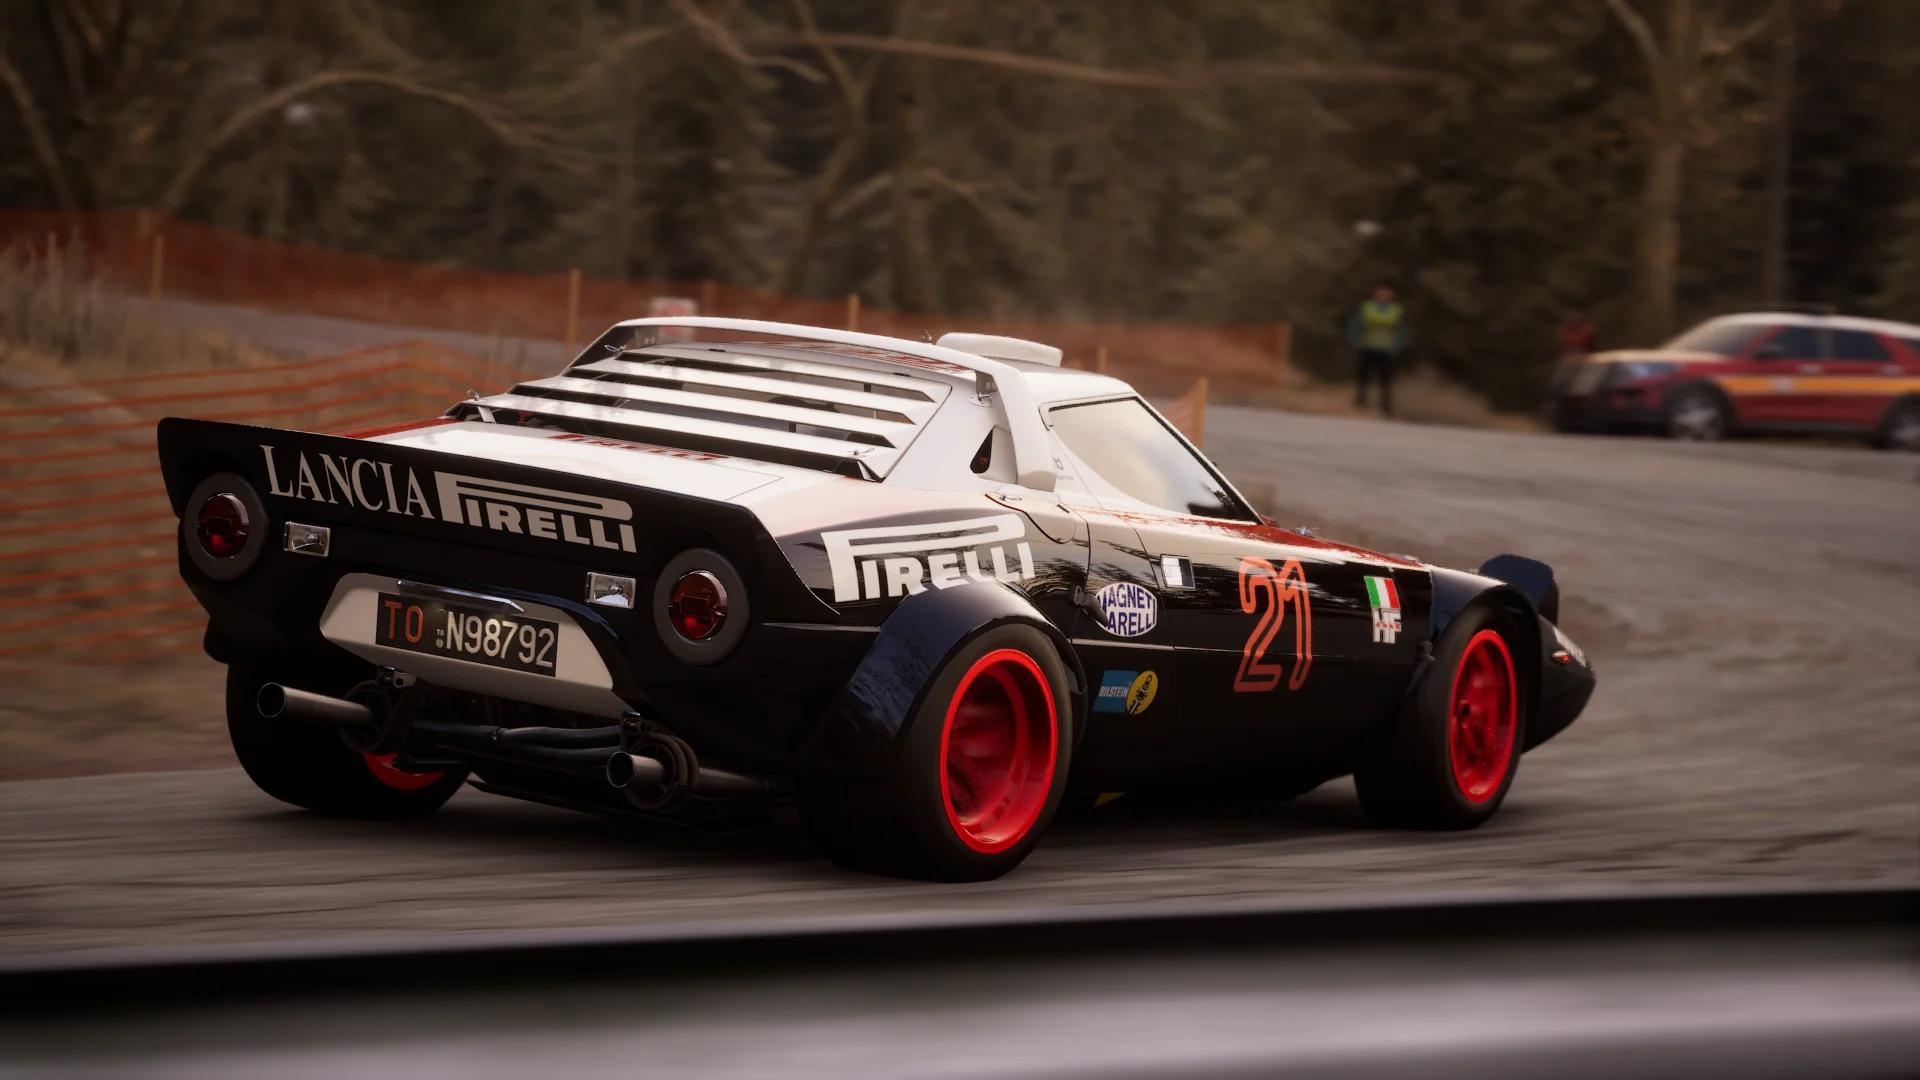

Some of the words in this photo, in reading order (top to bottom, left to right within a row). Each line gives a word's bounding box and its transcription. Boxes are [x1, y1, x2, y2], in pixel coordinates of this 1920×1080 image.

[259, 444, 435, 520] LANCIA
[434, 471, 637, 553] PIRELLI
[820, 513, 1036, 603] PIRELLI
[384, 599, 424, 644] TO
[446, 611, 556, 668] N98792
[1103, 610, 1156, 636] ARELLI
[1233, 555, 1313, 693] 21
[1098, 685, 1131, 698] BILSTEIN
